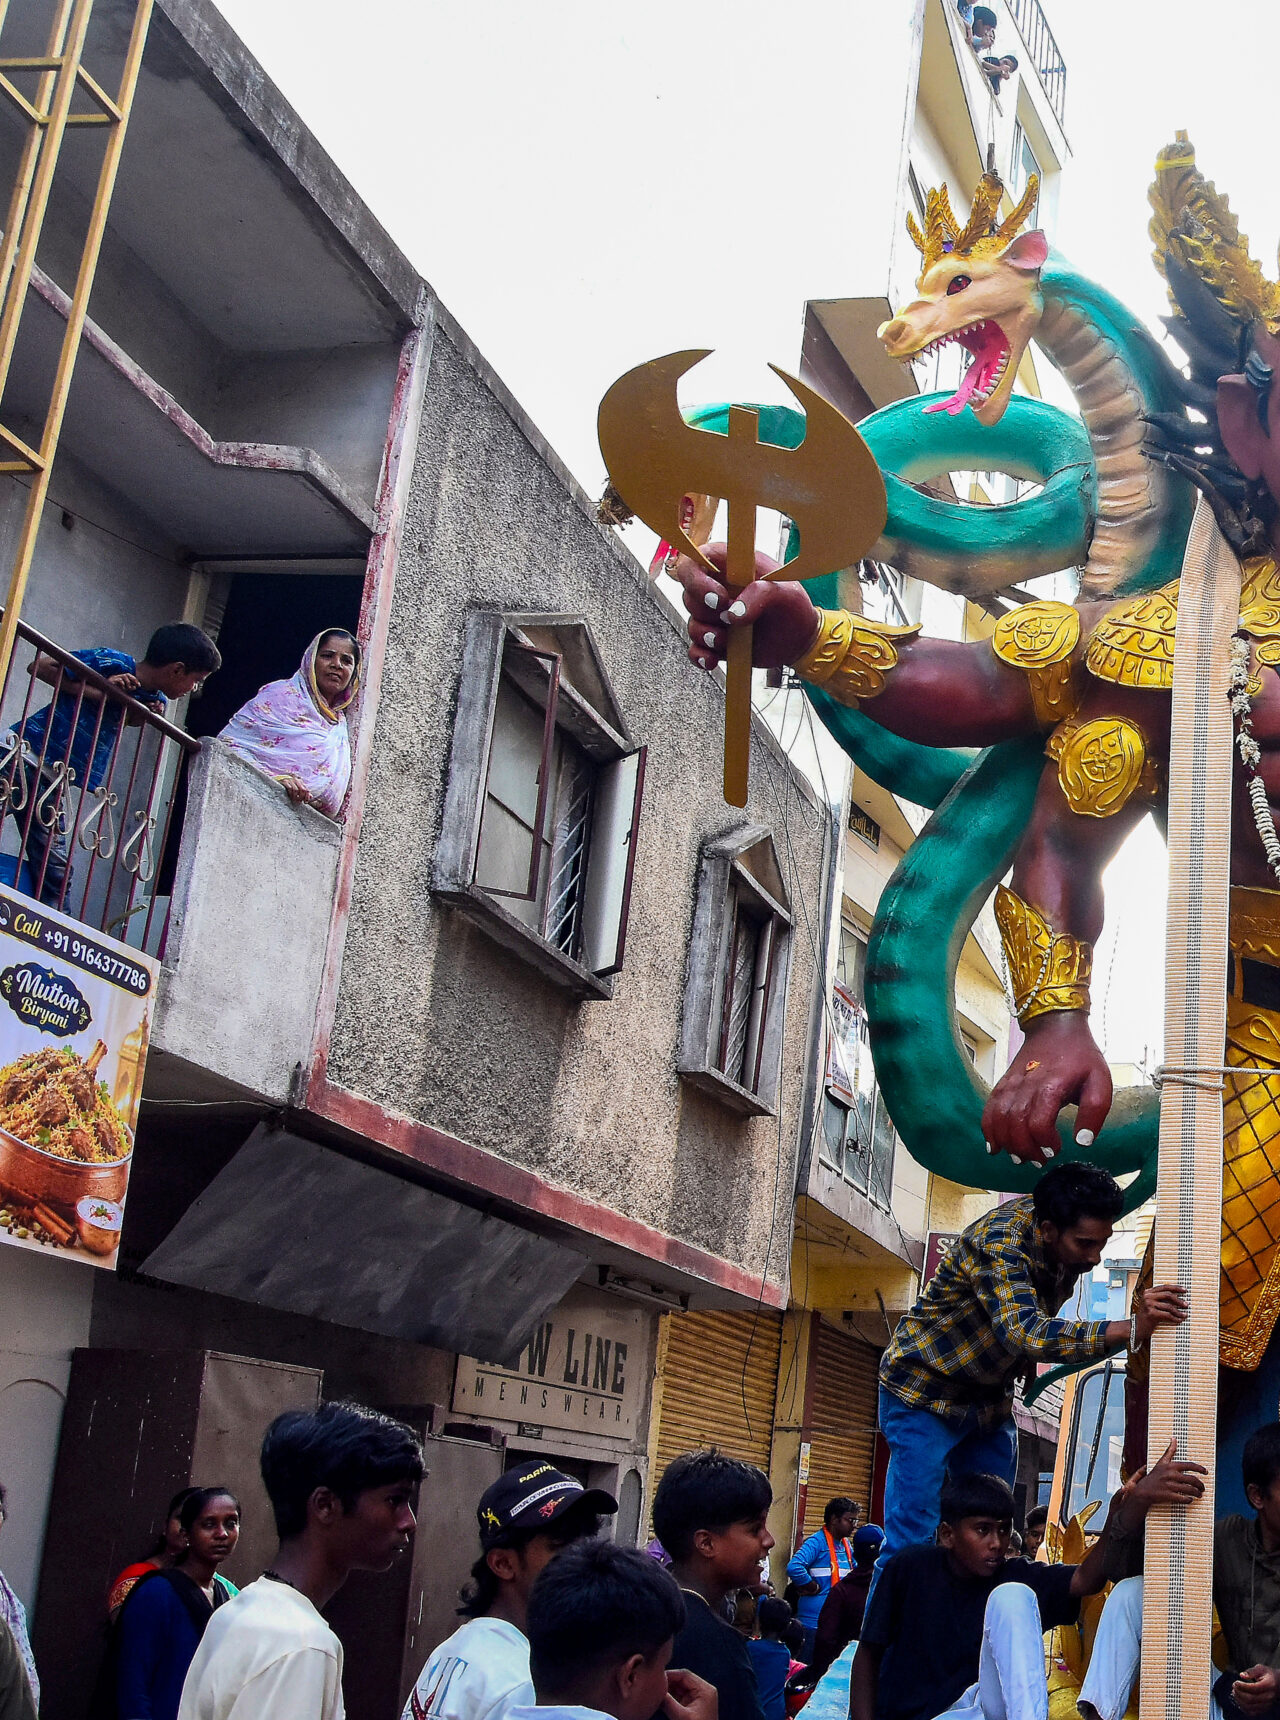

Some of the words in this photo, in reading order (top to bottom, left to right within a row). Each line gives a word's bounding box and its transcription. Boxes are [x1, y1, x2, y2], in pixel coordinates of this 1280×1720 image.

[14, 913, 42, 939] Call
[44, 930, 69, 953] +91
[72, 940, 147, 990] 9164377786
[16, 969, 80, 1015] Mutton
[20, 996, 70, 1029] Biryani
[563, 1328, 628, 1395] LINE
